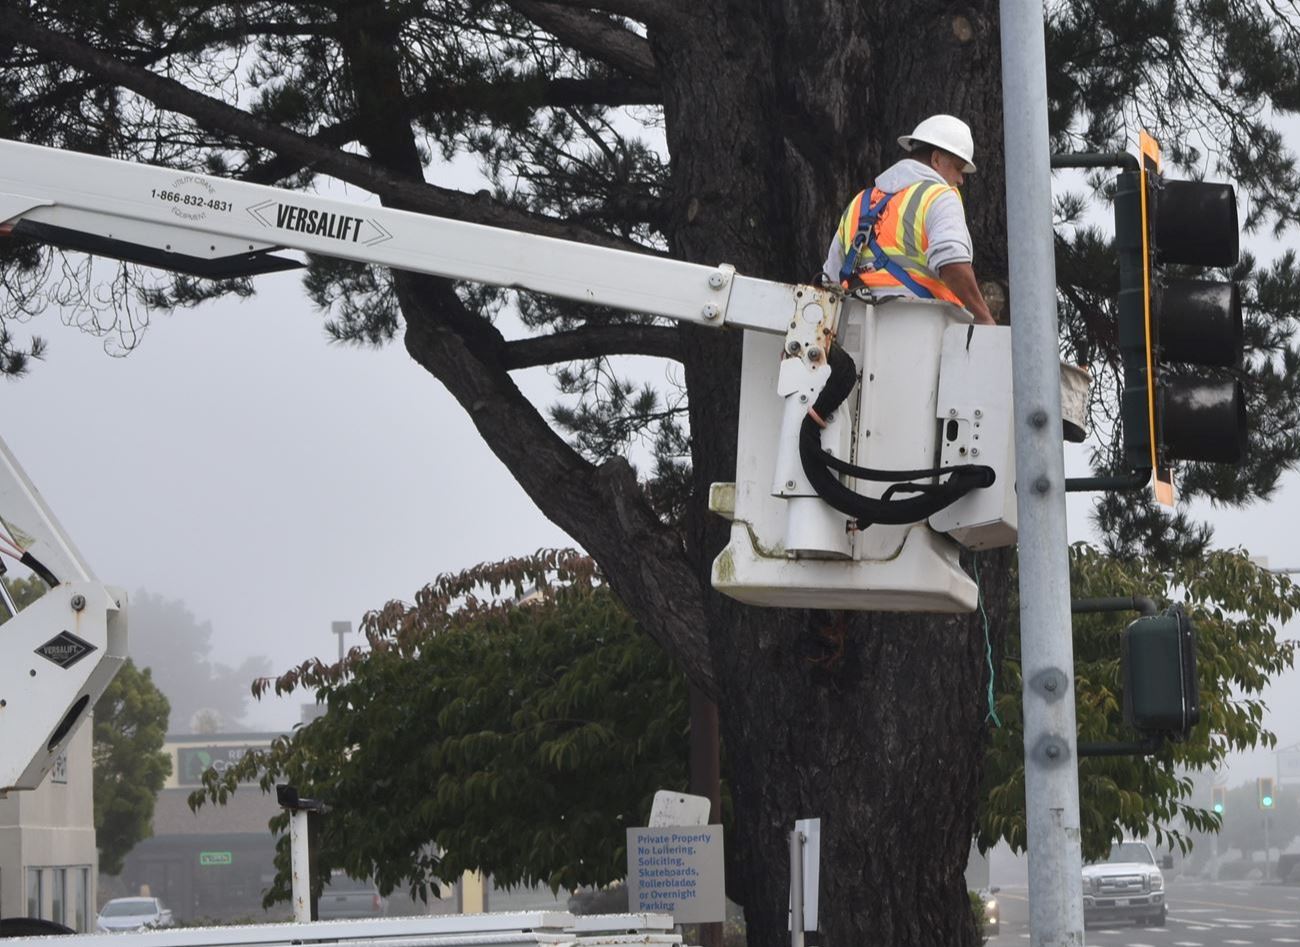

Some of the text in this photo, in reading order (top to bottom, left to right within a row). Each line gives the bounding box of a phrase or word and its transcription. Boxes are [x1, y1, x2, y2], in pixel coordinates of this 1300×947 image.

[172, 176, 193, 188] UTILITY
[151, 189, 233, 212] 1-866-832-4831
[276, 203, 364, 242] VERSALIFT
[43, 645, 77, 655] VERSALIFT
[637, 833, 711, 844] Private Property
[638, 845, 696, 855] No Loitering,
[638, 857, 685, 866] Soliciting,
[639, 868, 699, 877] Skateboards,
[640, 879, 696, 888] Rollerblades
[639, 889, 696, 900] or Overnight
[640, 901, 675, 911] Parking
